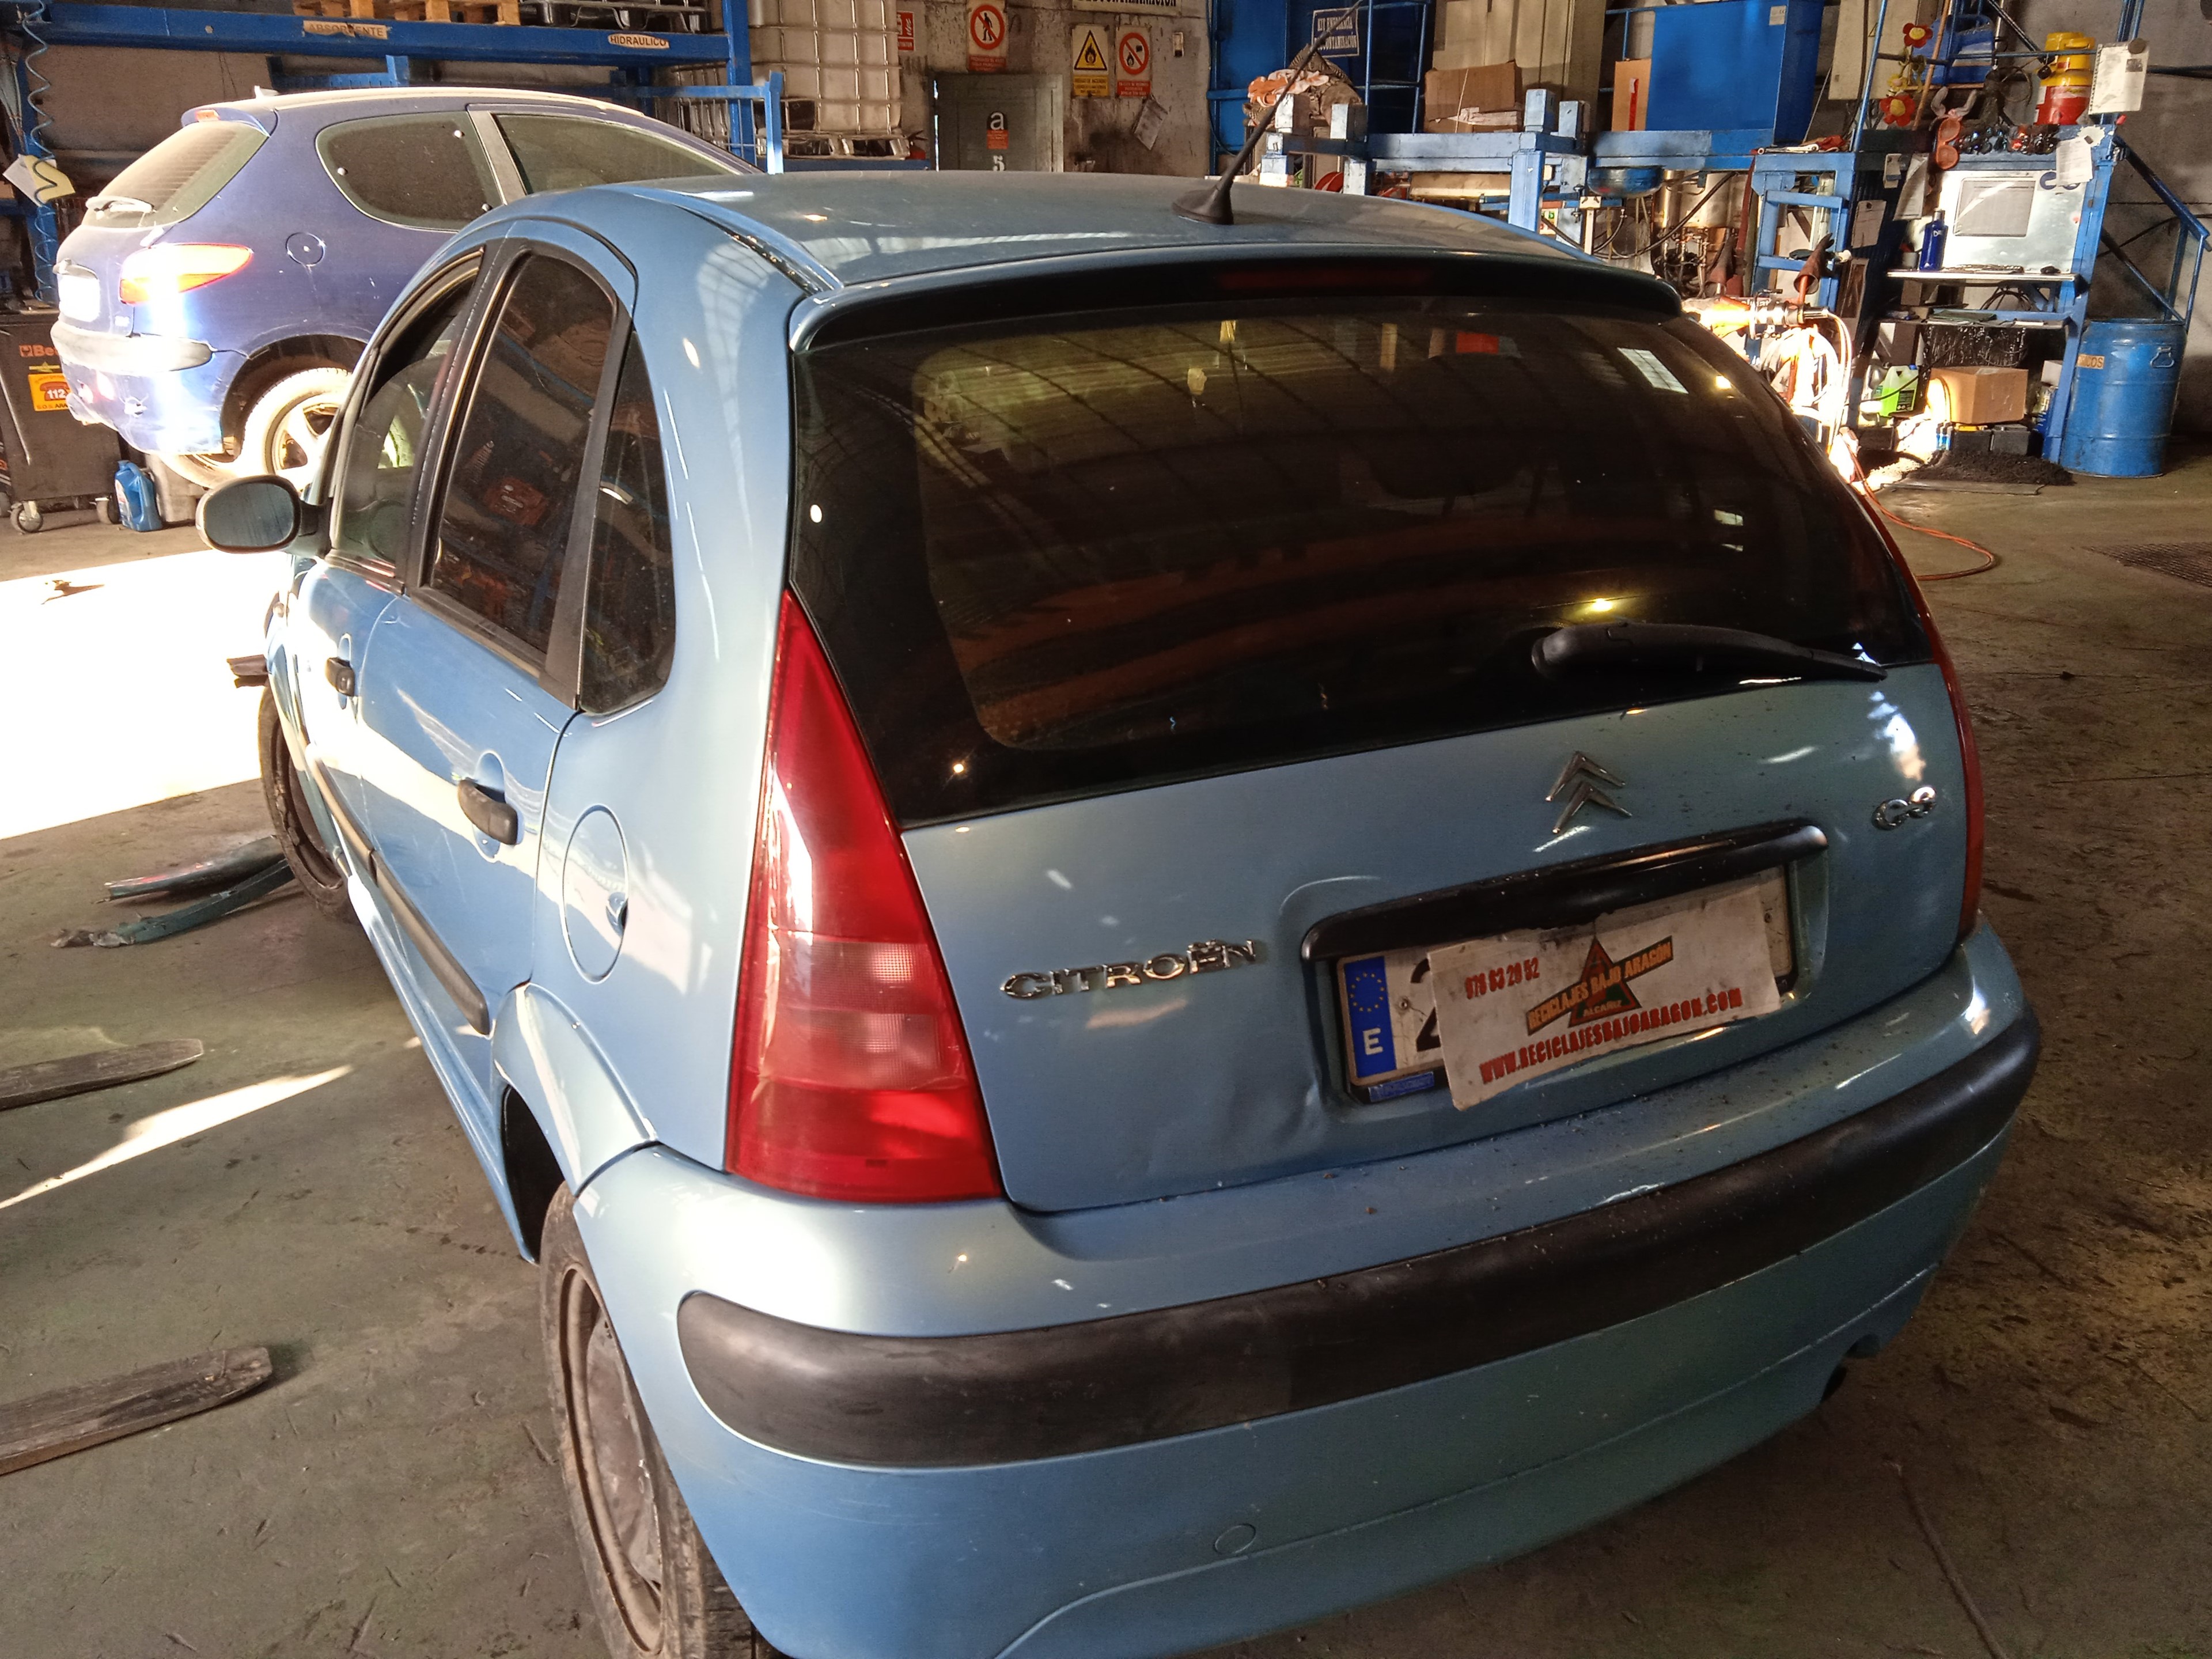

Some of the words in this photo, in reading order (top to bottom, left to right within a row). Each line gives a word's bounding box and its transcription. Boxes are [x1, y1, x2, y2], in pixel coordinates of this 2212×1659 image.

[309, 23, 384, 36] ABSORENTE
[611, 36, 666, 46] HIDRAULICO
[990, 112, 1004, 130] a
[993, 155, 1005, 171] 5
[47, 388, 66, 399] 112
[1000, 938, 1257, 1000] CITROËN
[1489, 967, 1506, 992] 83
[1506, 961, 1522, 987] 20
[1528, 981, 1590, 1030] RECICLAJES
[1590, 965, 1622, 993] BAJO
[1363, 1027, 1383, 1055] E
[1479, 988, 1743, 1085] WWW.RECICLAJESBAJOARAGON.COM
